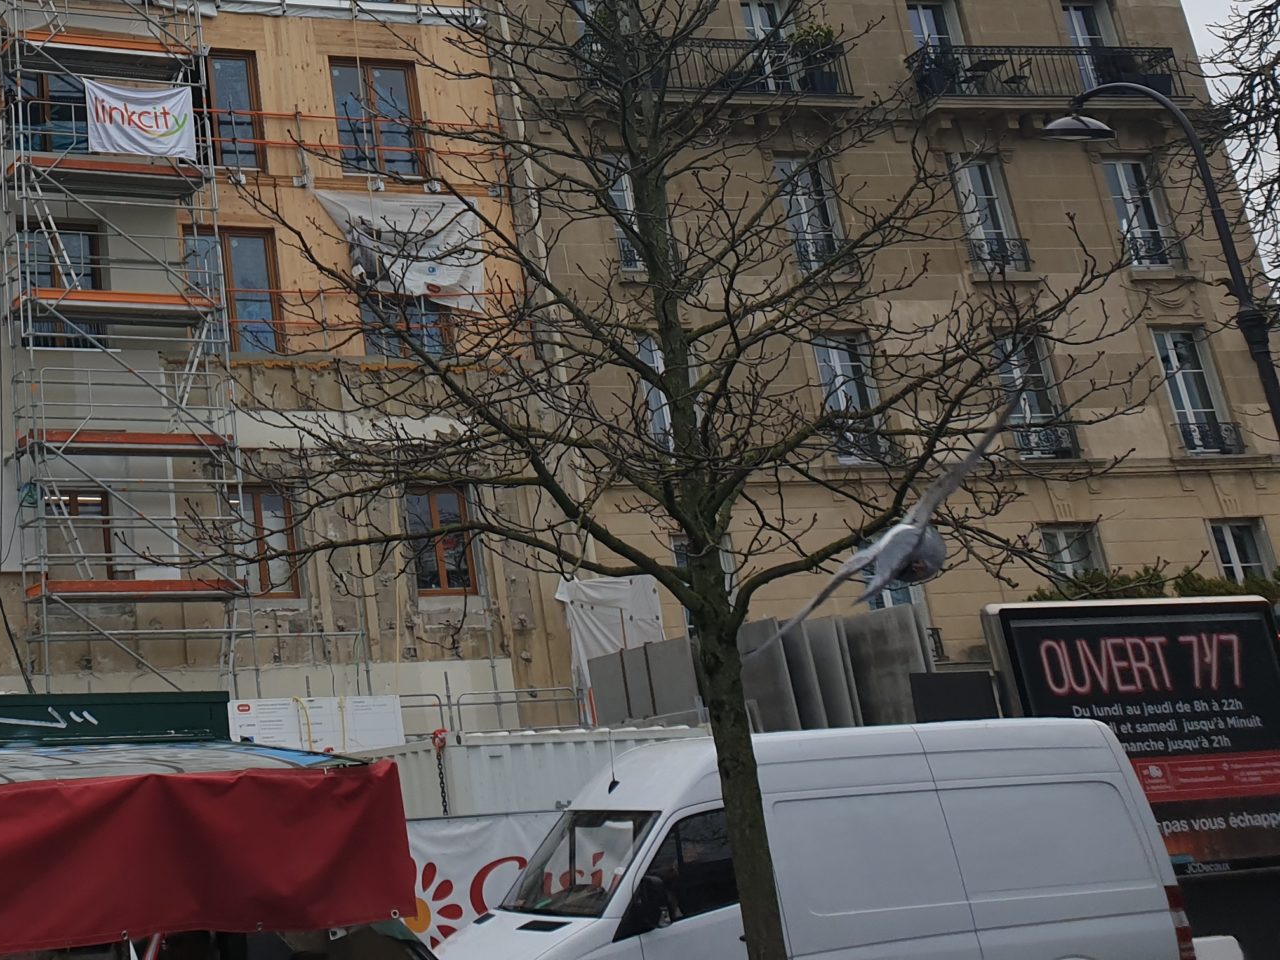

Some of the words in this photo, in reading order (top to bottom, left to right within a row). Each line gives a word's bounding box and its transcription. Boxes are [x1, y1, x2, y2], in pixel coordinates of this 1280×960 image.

[93, 95, 189, 138] linkcity
[1039, 635, 1173, 696] OUVERT
[1071, 704, 1090, 718] Du
[1092, 703, 1122, 718] lundi
[1126, 705, 1141, 716] au
[1142, 701, 1173, 717] jeudi
[1175, 701, 1191, 713] de
[1193, 699, 1209, 712] 8h
[1212, 700, 1220, 712] à
[1222, 698, 1243, 711] 22h
[1121, 722, 1134, 734] et
[1136, 718, 1178, 734] samedi
[1182, 716, 1224, 733] jusqu'à
[1227, 714, 1263, 729] Minuit
[1121, 739, 1165, 753] manche
[1166, 737, 1209, 753] jusqu'à
[1212, 735, 1232, 748] 21h
[1162, 820, 1189, 837] pas
[1191, 816, 1227, 832] vous
[1184, 862, 1232, 874] JCDecaux
